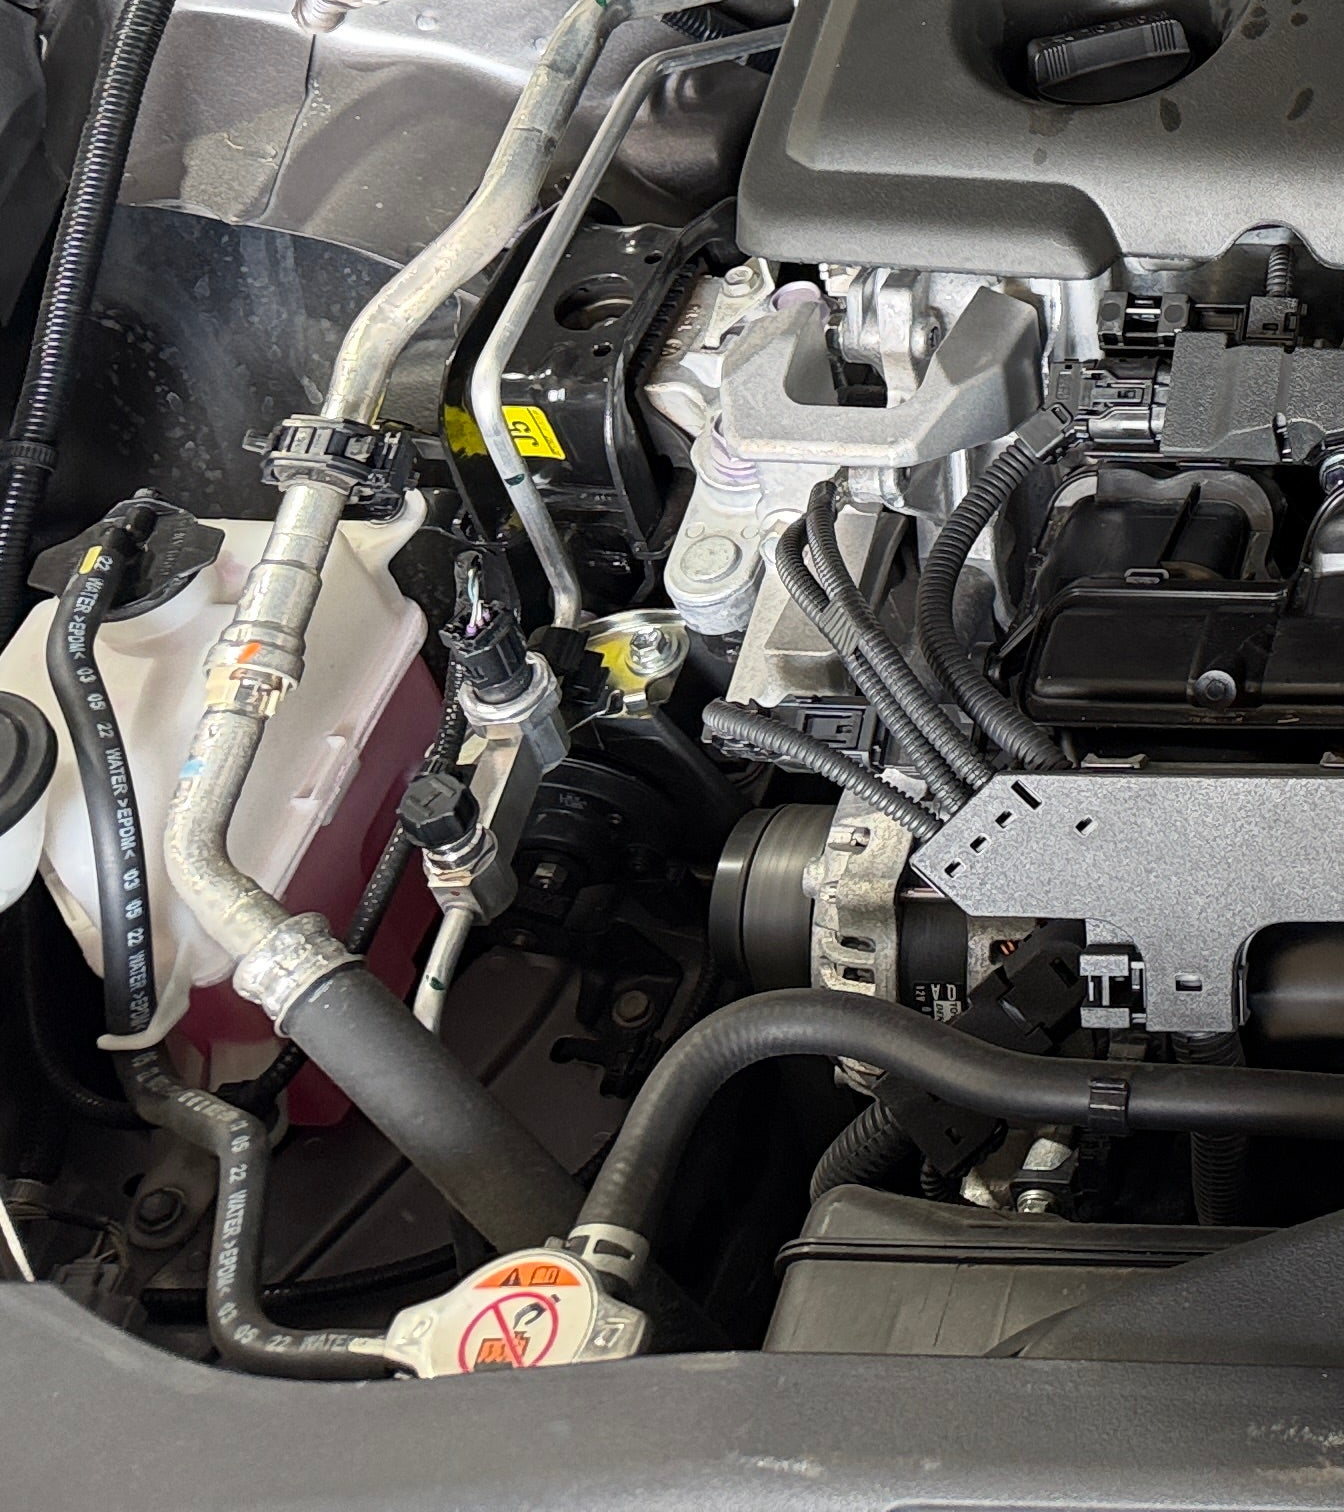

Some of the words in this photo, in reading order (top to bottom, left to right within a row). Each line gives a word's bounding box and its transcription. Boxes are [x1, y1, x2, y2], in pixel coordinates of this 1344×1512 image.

[94, 554, 113, 571] 22
[72, 576, 104, 614] WATER
[75, 666, 96, 684] 03
[87, 692, 106, 710] 05
[95, 721, 114, 740] 22
[104, 746, 127, 796] WATER
[114, 797, 137, 861] >EPDM<
[122, 868, 141, 890] 03
[126, 927, 145, 947] 22
[127, 949, 147, 992] WATER
[915, 985, 926, 1002] 12V
[231, 1135, 250, 1153] 05
[229, 1163, 248, 1184] 22
[223, 1189, 248, 1240] WATER
[217, 1300, 237, 1325] 03
[264, 1333, 292, 1353] 22
[300, 1332, 352, 1354] WATE
